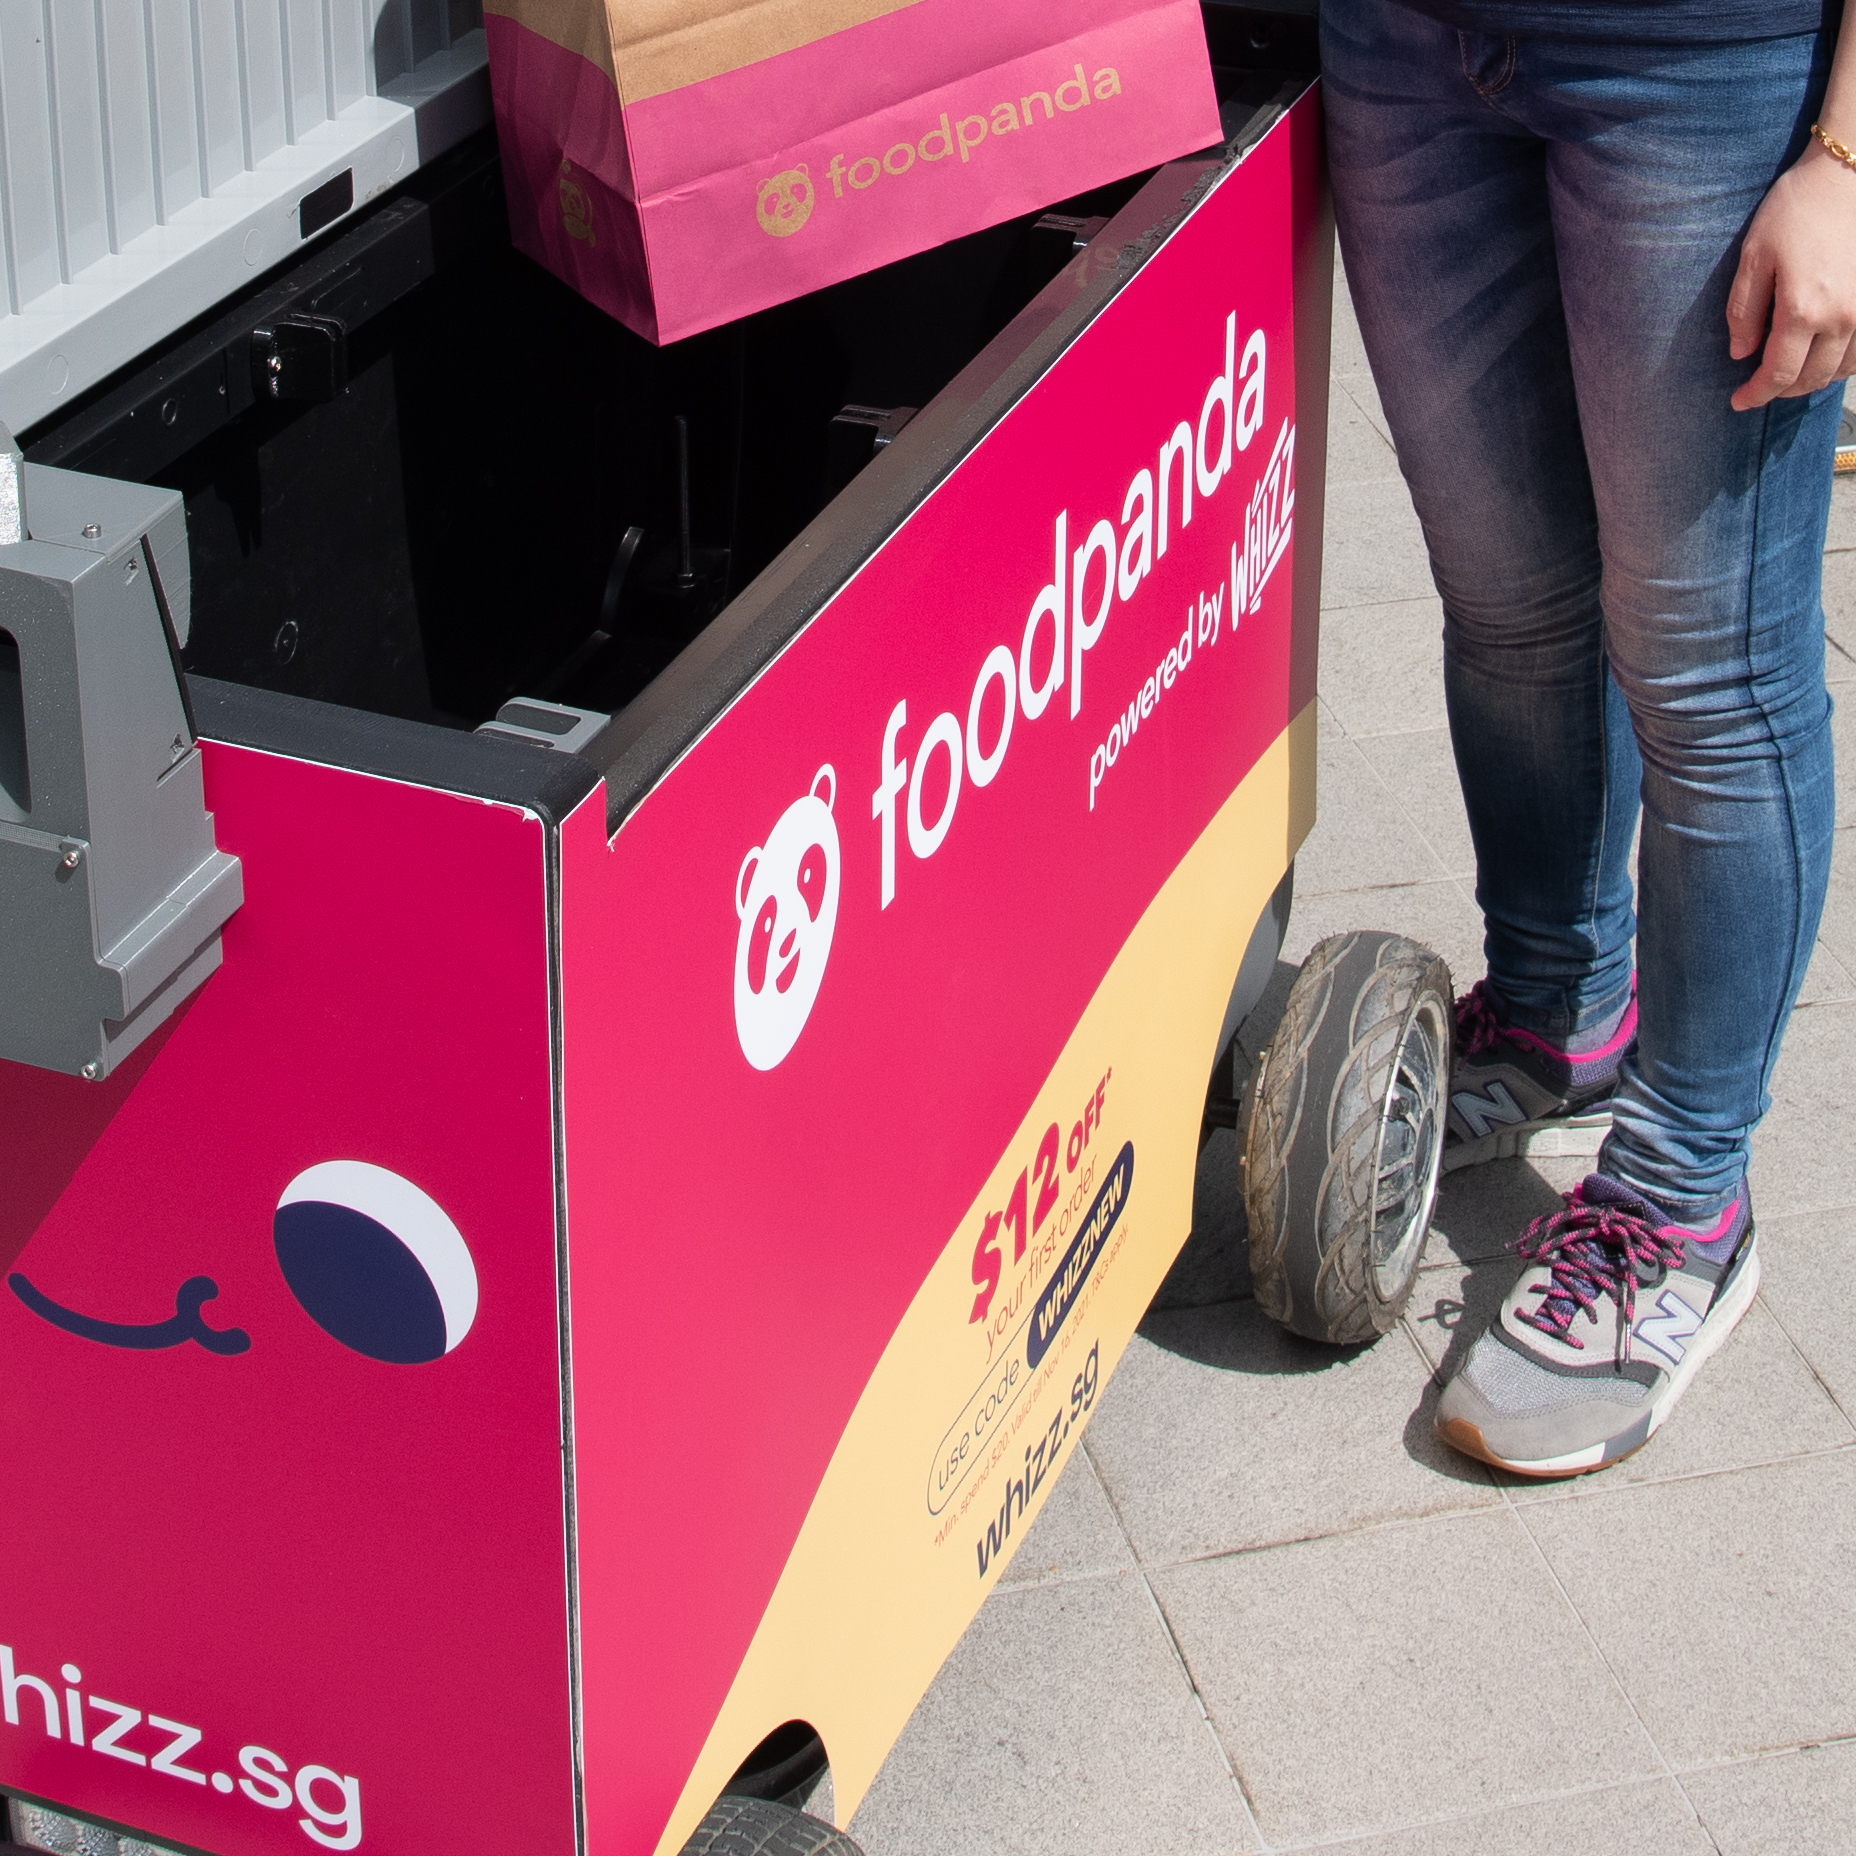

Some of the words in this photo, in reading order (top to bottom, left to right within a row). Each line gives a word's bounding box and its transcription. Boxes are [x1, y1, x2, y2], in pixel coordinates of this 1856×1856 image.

[825, 62, 1122, 199] foodpanda
[872, 310, 1266, 911] foodpanda
[1089, 605, 1193, 811] powered
[1198, 581, 1225, 648] by
[1231, 417, 1295, 632] WHIZZ
[938, 1431, 970, 1492] use
[974, 1359, 1020, 1437] code
[1038, 1162, 1124, 1342] WHIZZNEW
[968, 1122, 1060, 1325] $12
[986, 1273, 1026, 1365] your
[1029, 1223, 1057, 1289] first
[1059, 1153, 1097, 1237] order
[960, 1457, 990, 1515] spend
[1011, 1393, 1033, 1436] Valid
[976, 1337, 1100, 1580] whizz.sg
